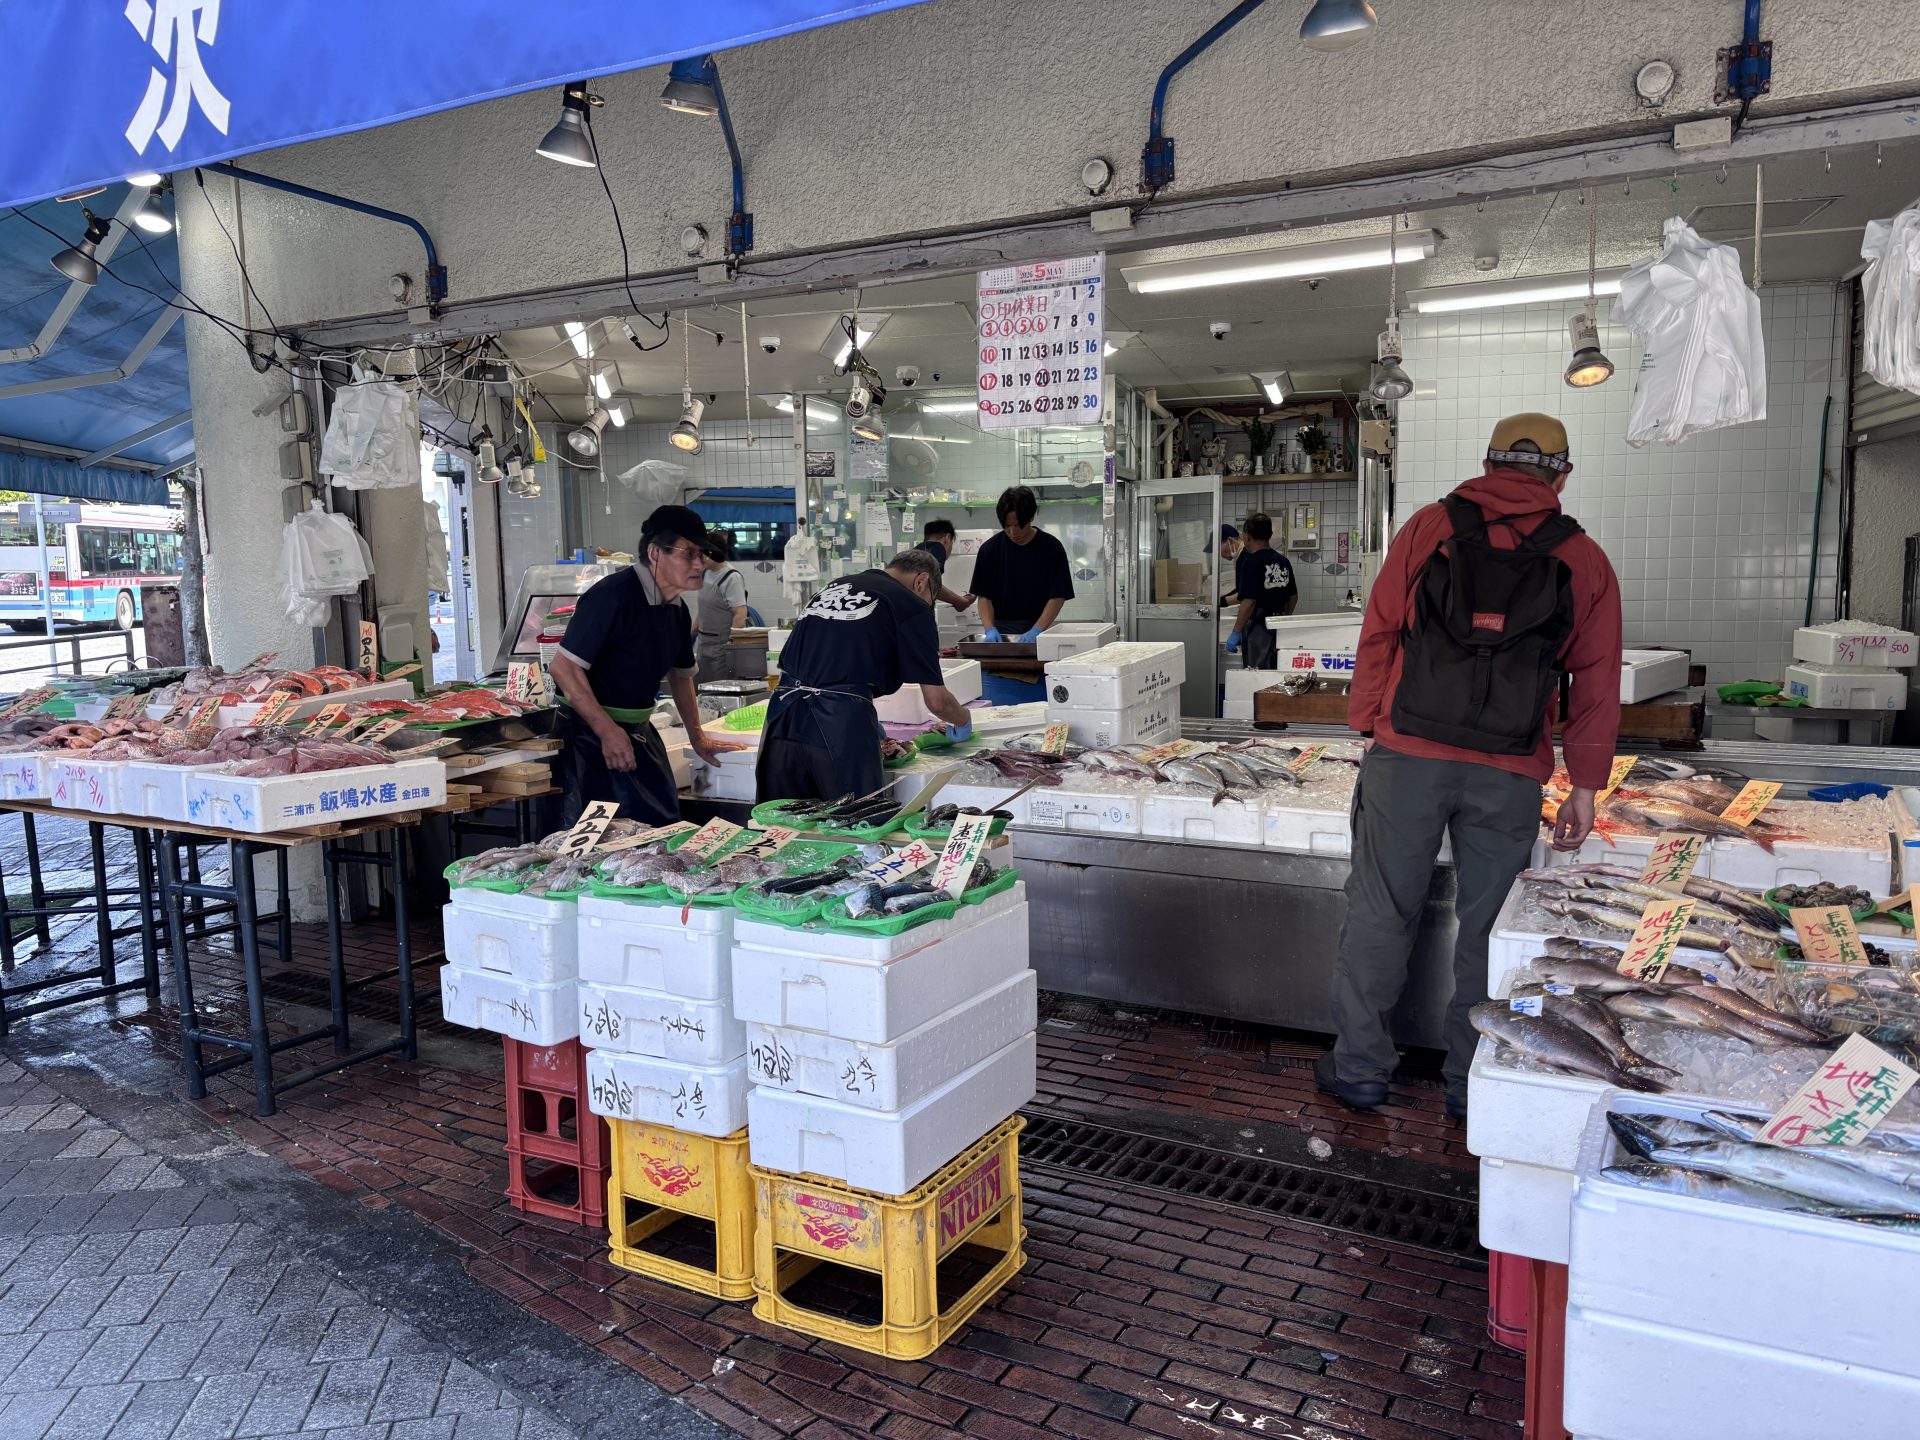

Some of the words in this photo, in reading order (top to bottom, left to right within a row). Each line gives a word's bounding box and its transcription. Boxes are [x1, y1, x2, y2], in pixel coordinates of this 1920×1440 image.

[1019, 270, 1034, 279] 2026
[1034, 264, 1046, 279] 5
[1046, 266, 1064, 276] MAY
[1071, 286, 1077, 300] 1
[1087, 284, 1095, 299] 2
[985, 322, 994, 336] 3
[1003, 320, 1010, 335] 4
[1020, 318, 1027, 333] 5
[1037, 318, 1044, 332] 6
[1053, 315, 1061, 330] 7
[1070, 314, 1078, 328] 8
[1087, 312, 1095, 327] 9
[983, 348, 995, 364] 10
[1002, 347, 1012, 361] 11
[1018, 346, 1031, 360] 12
[1035, 344, 1047, 360] 13
[1052, 343, 1064, 357] 14
[1068, 340, 1079, 355] 15
[1085, 338, 1097, 353] 16
[983, 374, 995, 390] 17
[1001, 373, 1014, 388] 18
[1018, 372, 1032, 387] 19
[1036, 371, 1049, 386] 20
[1051, 369, 1063, 384] 21
[1066, 368, 1080, 382] 22
[1083, 366, 1098, 381] 23
[1001, 400, 1015, 415] 25
[1018, 399, 1032, 413] 26
[1035, 397, 1049, 413] 27
[1051, 397, 1064, 411] 28
[1066, 395, 1079, 410] 29
[1083, 394, 1098, 409] 30
[10, 586, 36, 595] おはぎ
[1836, 641, 1856, 662] 5/9
[1849, 635, 1888, 648] ヤリイカ
[1890, 640, 1910, 654] 500
[1291, 656, 1316, 669] 厚岸
[283, 802, 316, 818] 三浦市
[319, 782, 398, 813] 飯嶋水産
[401, 786, 431, 801] 金田港
[959, 821, 987, 867] 長井産
[1641, 838, 1687, 885] 地コチ
[1643, 902, 1695, 966] 長井産
[1825, 910, 1867, 963] 長井産
[1812, 1066, 1900, 1145] 長井産
[940, 1165, 1002, 1248] KIRIN
